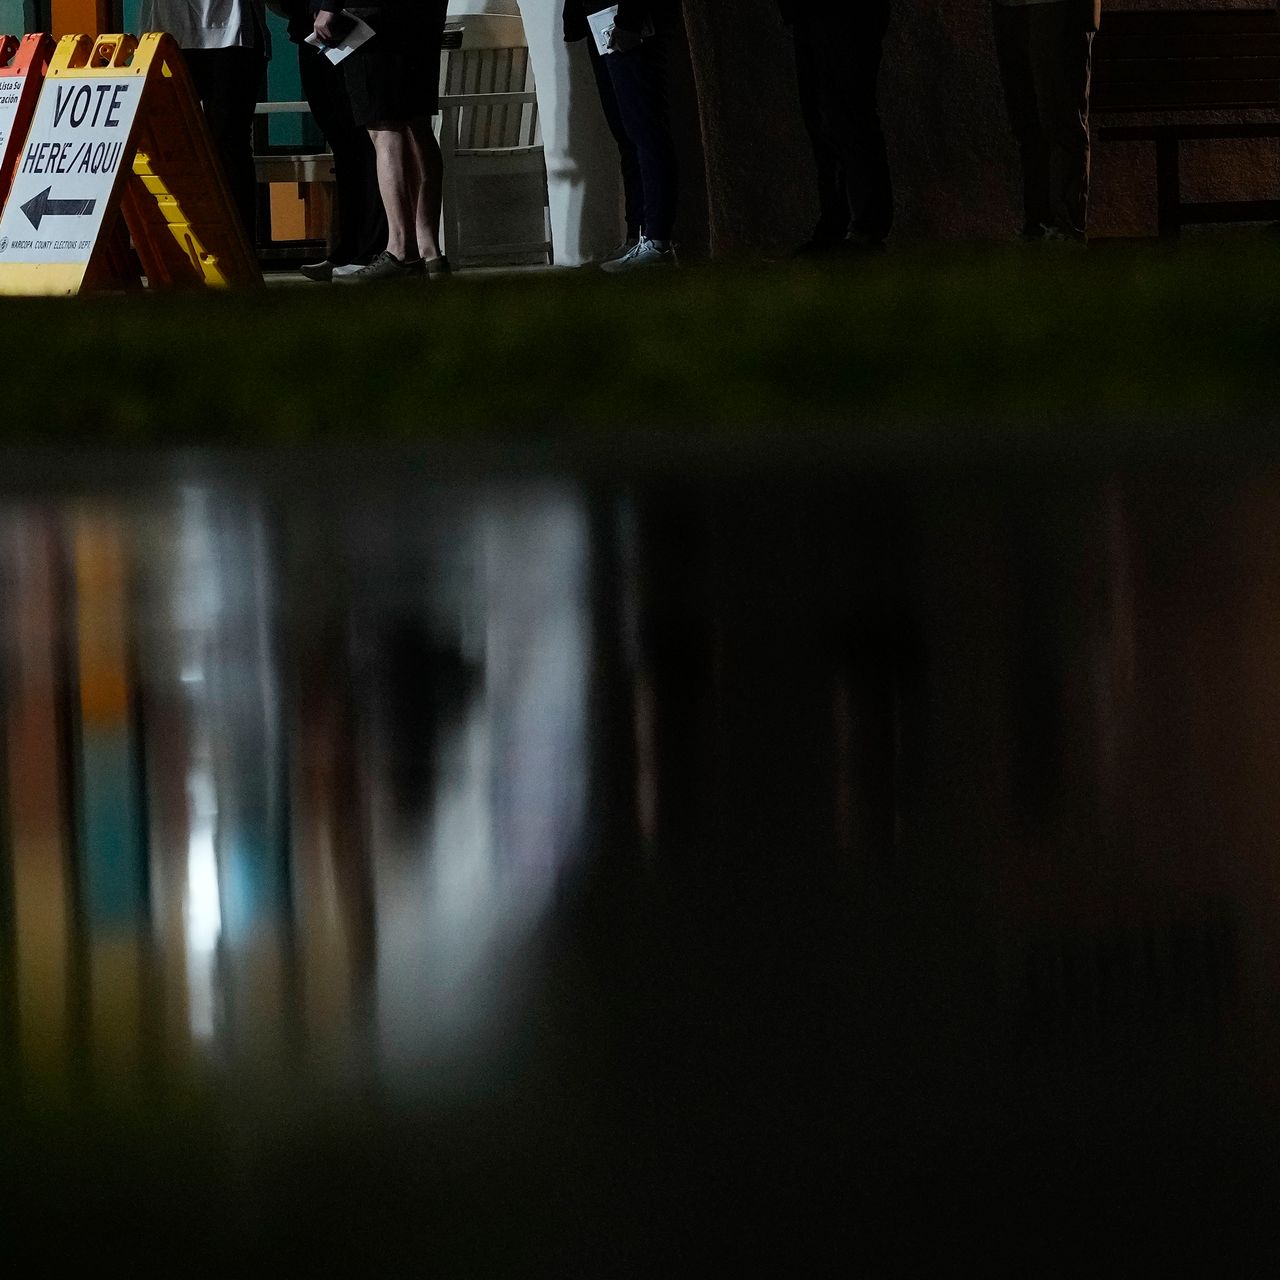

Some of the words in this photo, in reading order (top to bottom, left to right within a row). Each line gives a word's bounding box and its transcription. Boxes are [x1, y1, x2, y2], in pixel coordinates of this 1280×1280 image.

[14, 81, 21, 91] Su
[53, 84, 129, 128] VOTE
[22, 142, 122, 174] HERE/AQUI
[11, 240, 33, 249] MARICOPA
[34, 240, 53, 249] COUNTY
[53, 240, 78, 249] ELECTIONS
